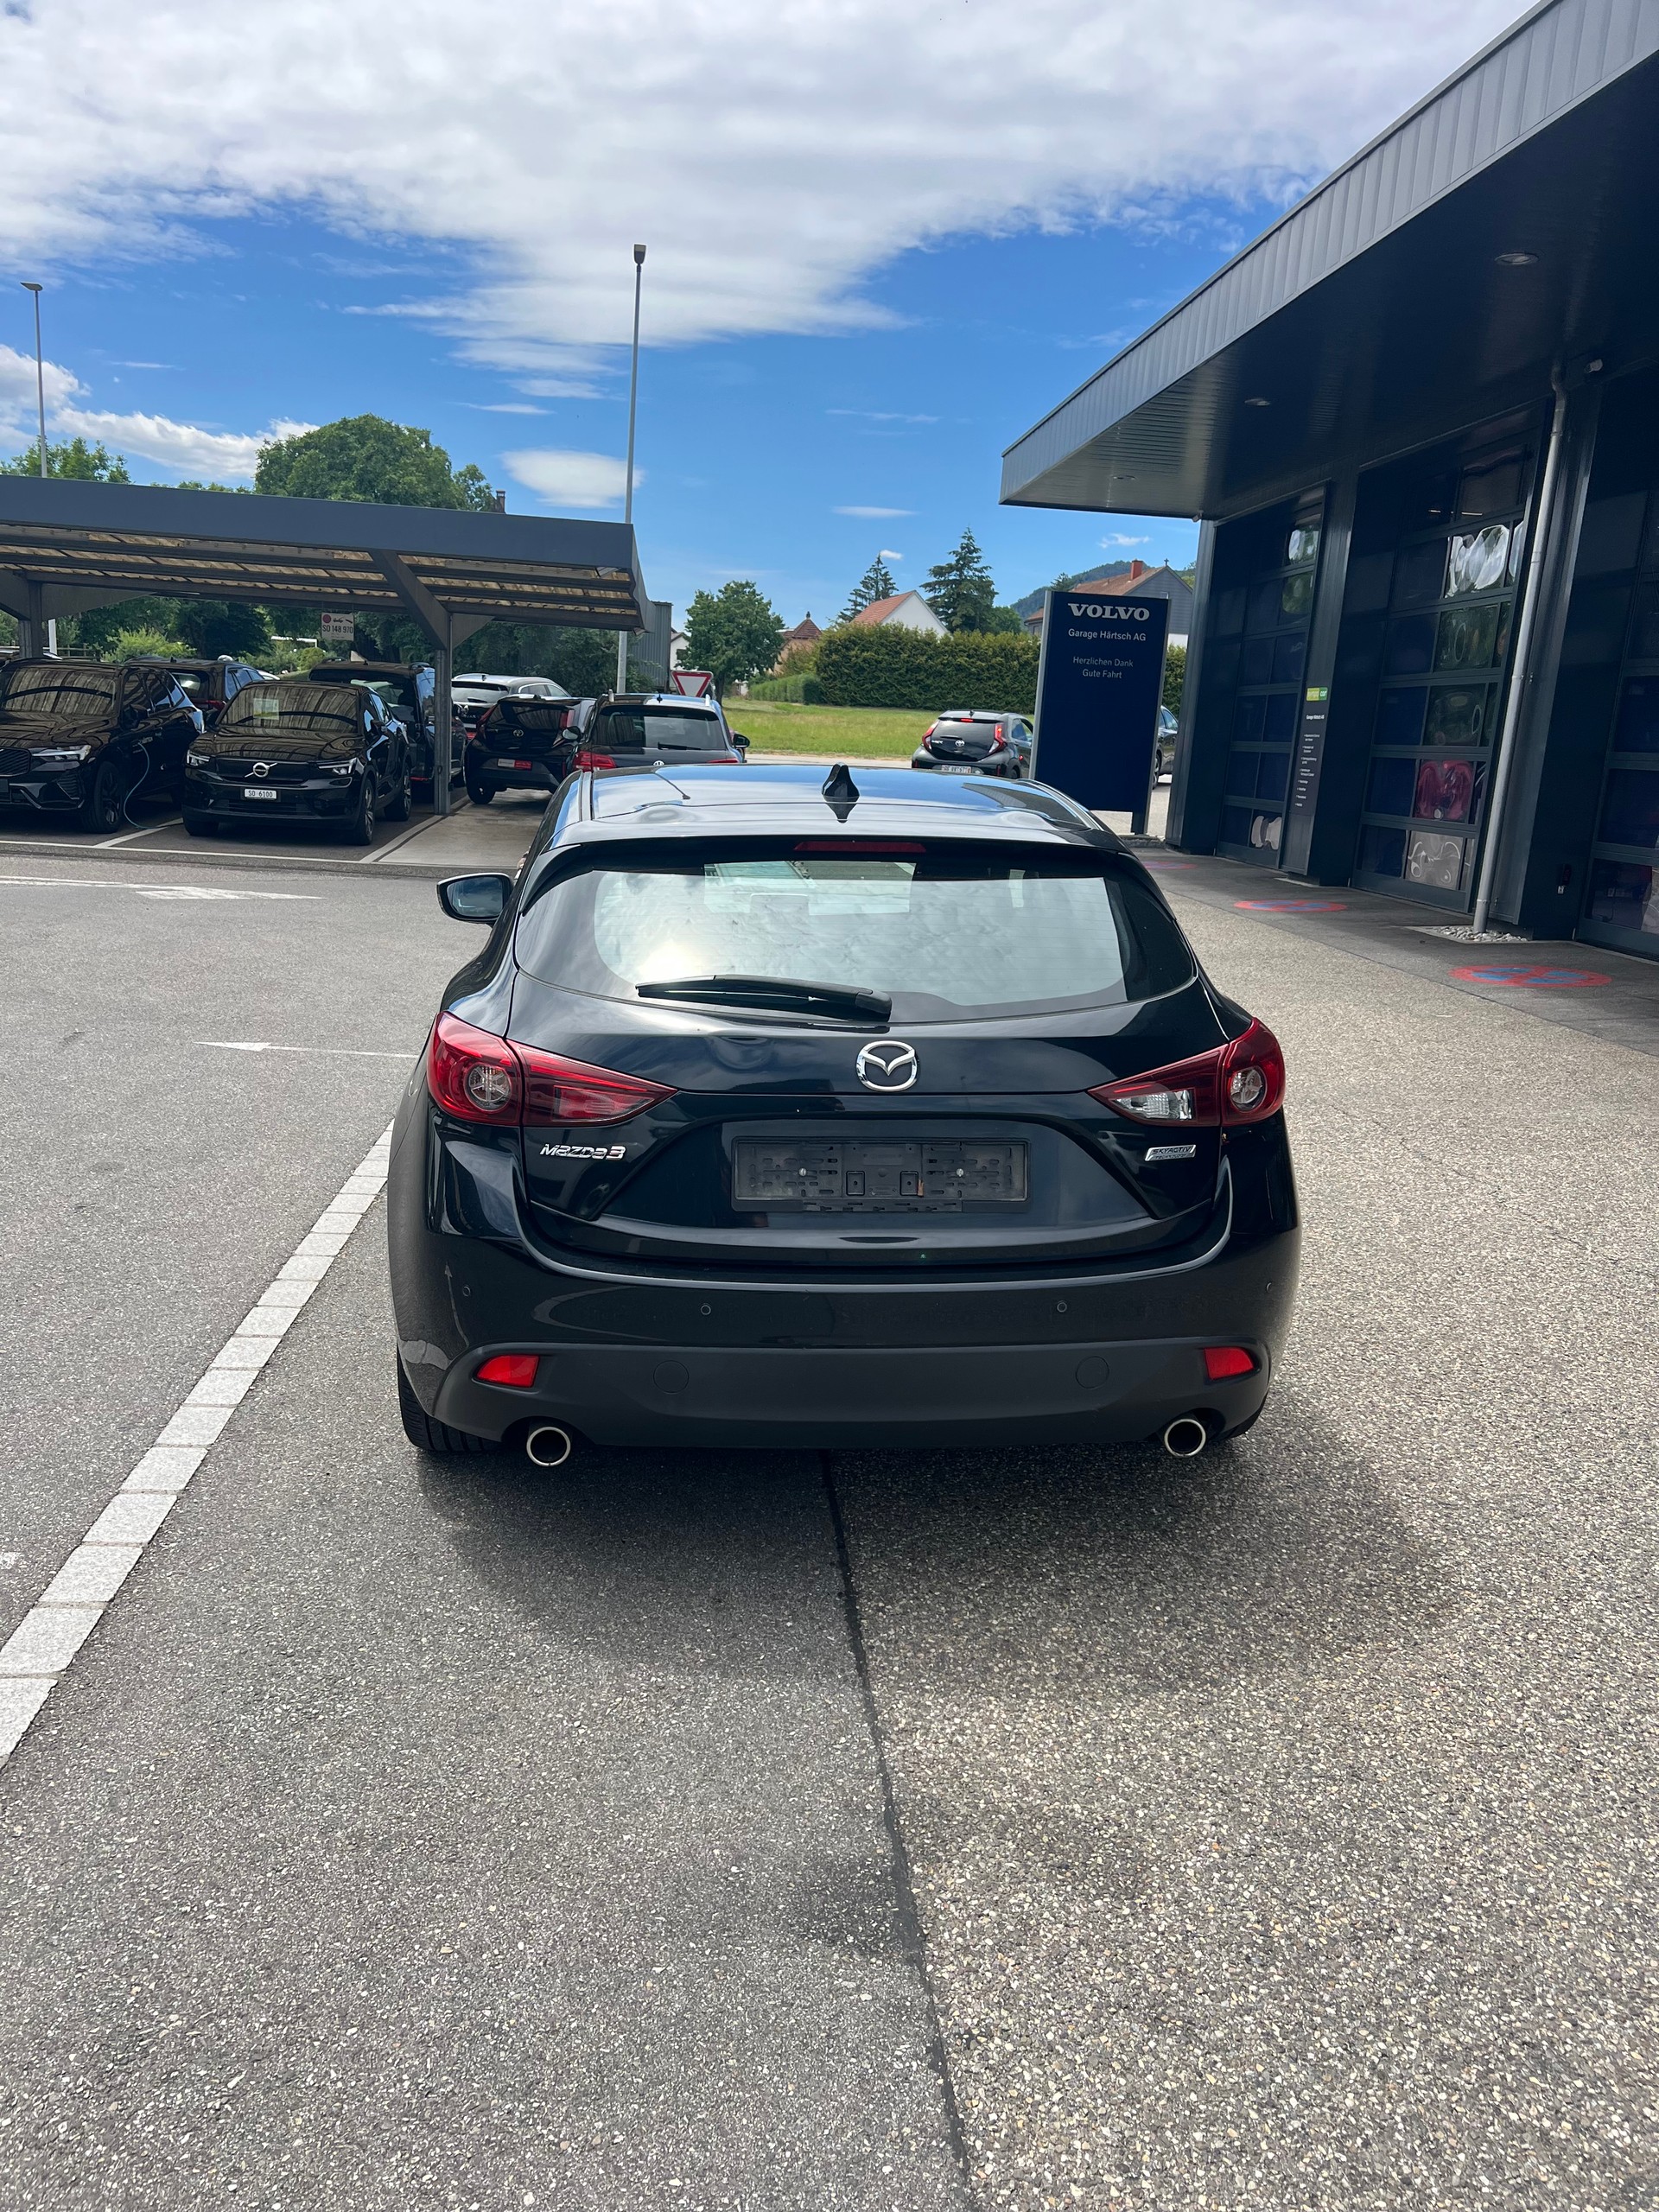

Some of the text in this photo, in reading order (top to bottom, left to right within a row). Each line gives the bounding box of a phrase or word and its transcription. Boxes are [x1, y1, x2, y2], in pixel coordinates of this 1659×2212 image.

[1068, 603, 1150, 620] VOLVO
[1068, 628, 1146, 641] Garage Härtsch AG
[1072, 656, 1134, 667] Herzlichen Dank
[1082, 668, 1122, 678] Gute Fahrt
[1152, 1146, 1192, 1154] SKYACTIV
